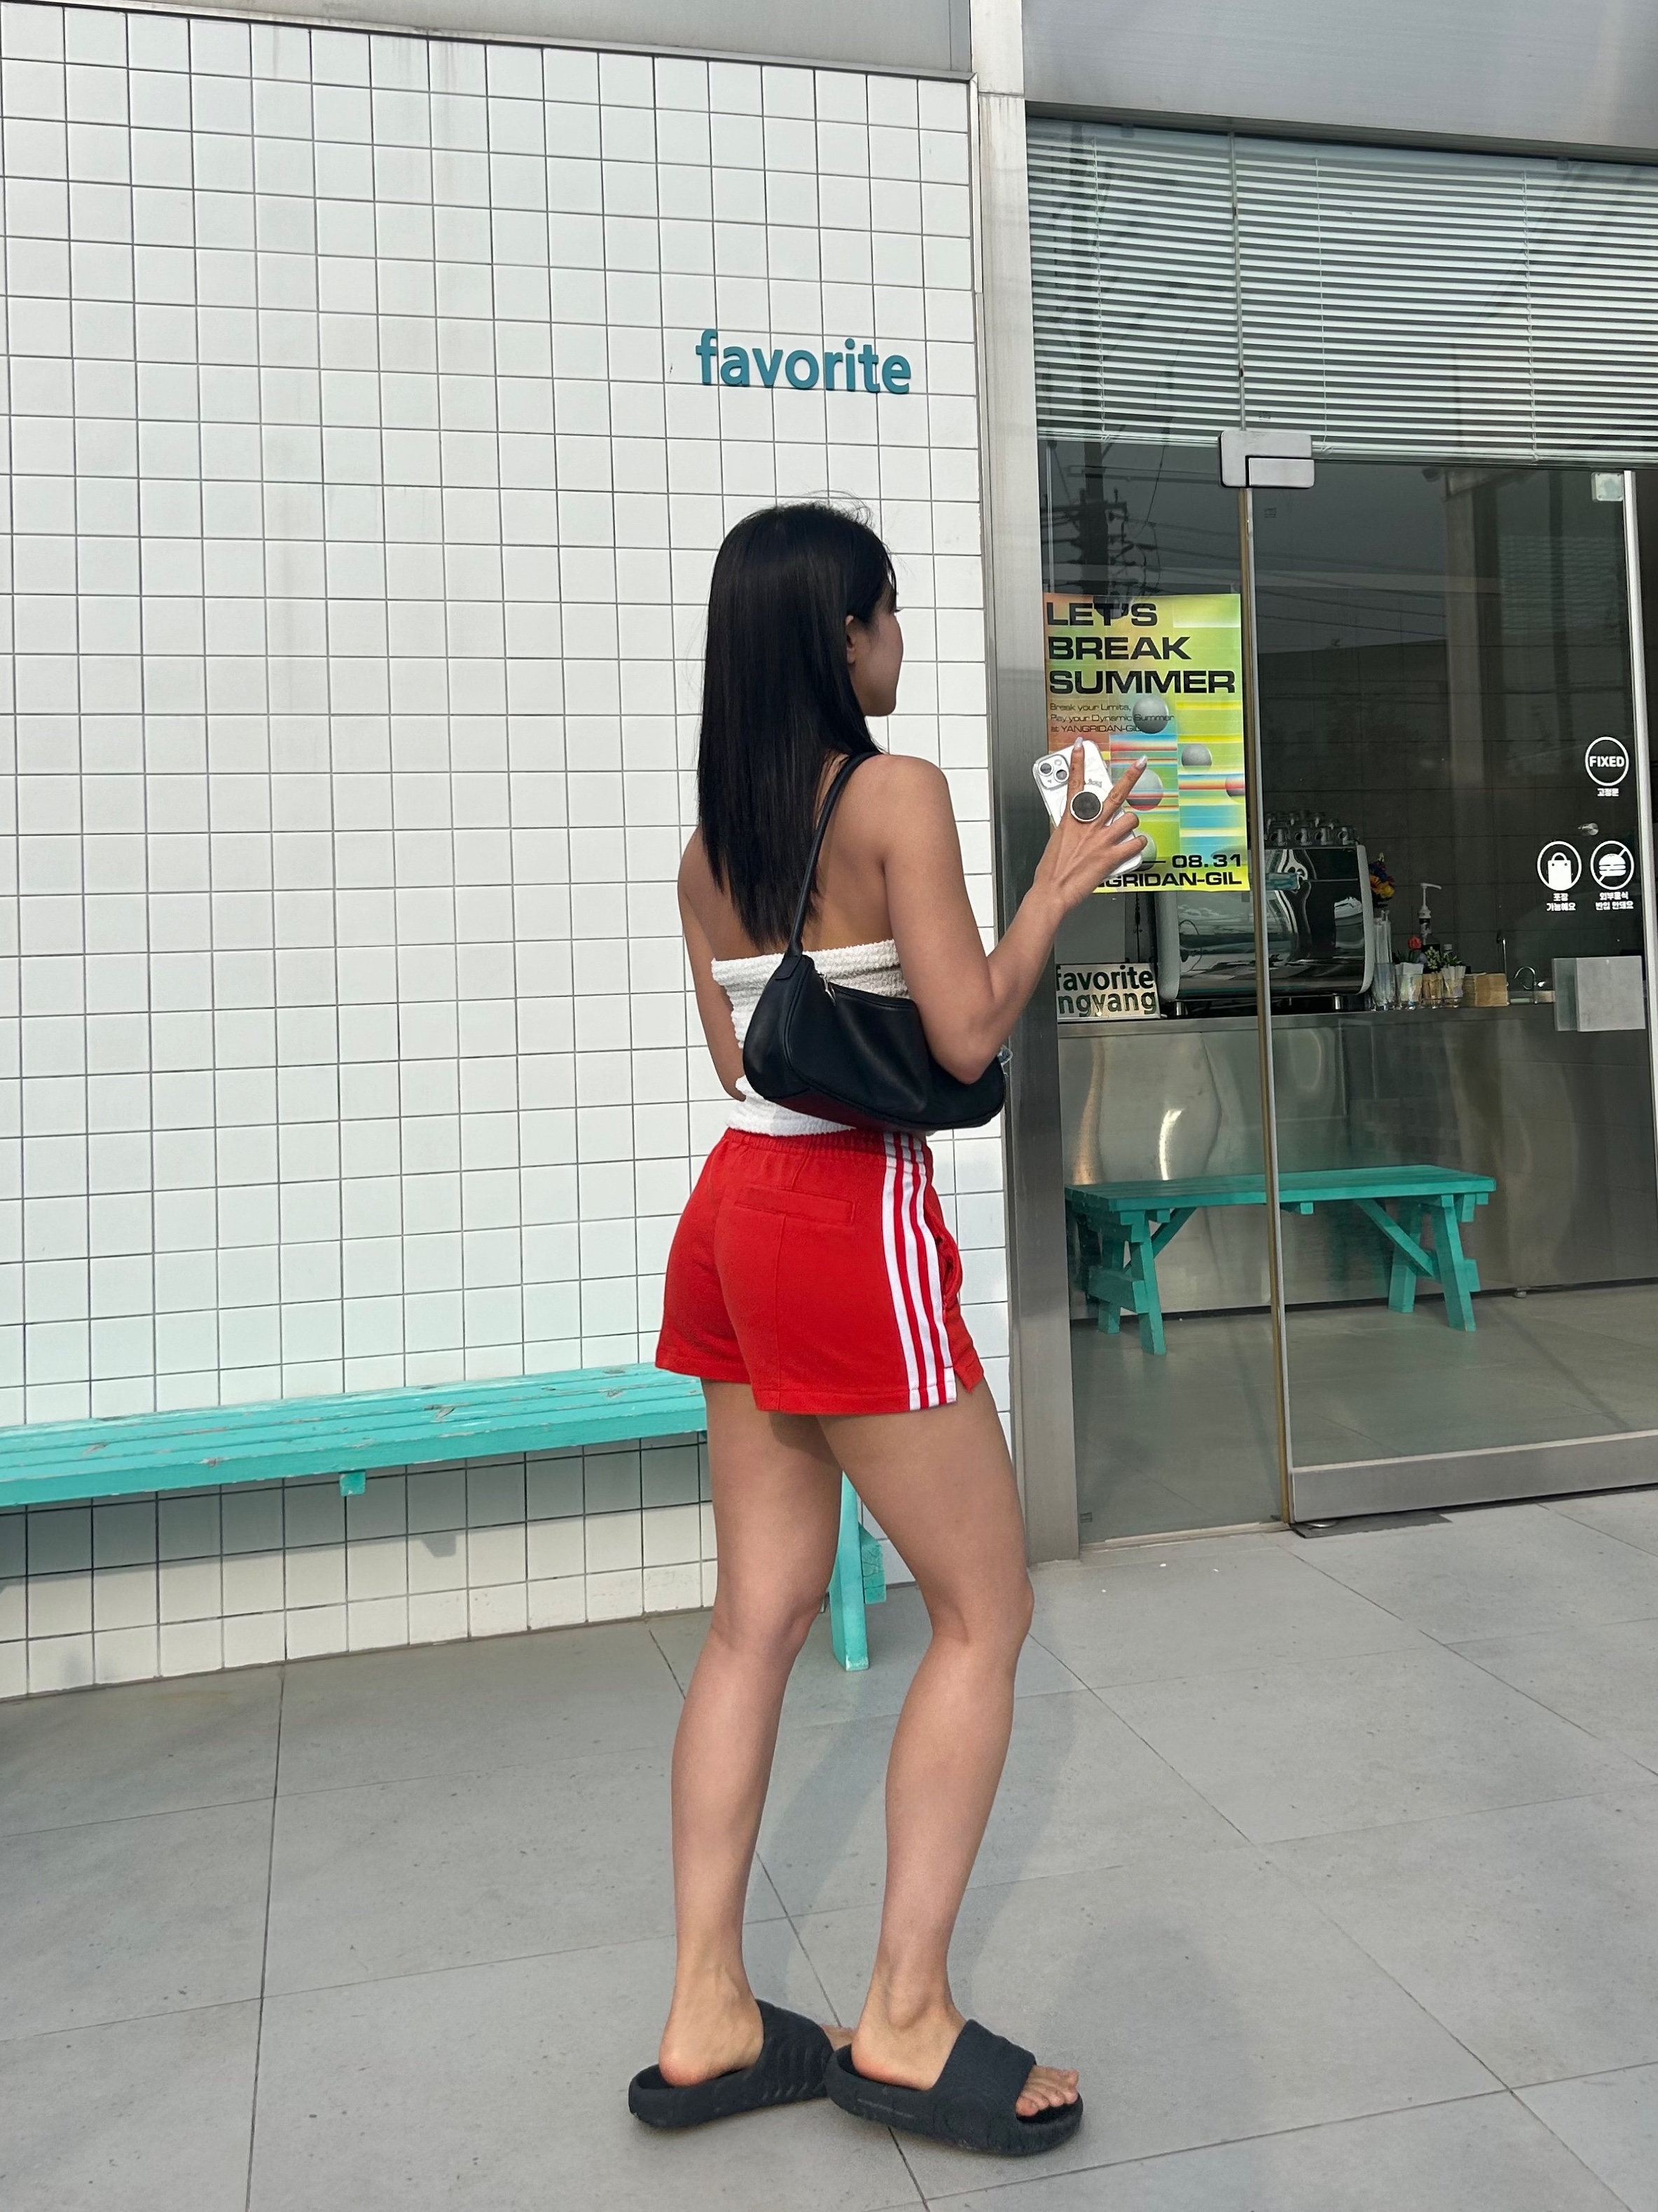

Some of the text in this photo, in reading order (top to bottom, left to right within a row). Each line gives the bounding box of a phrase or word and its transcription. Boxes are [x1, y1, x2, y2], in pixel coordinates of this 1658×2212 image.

[696, 329, 912, 394] favorite
[1046, 602, 1158, 626] LET'S
[1048, 636, 1192, 660] BREAK
[1049, 670, 1236, 694] SUMMER
[1050, 703, 1075, 711] Break
[1091, 714, 1133, 723] Dynamic
[1589, 755, 1625, 767] FIXED
[1597, 788, 1619, 797] 고정문
[1172, 853, 1241, 868] 08.31
[1098, 872, 1242, 888] GRIDAN-GIL
[1553, 893, 1568, 902] 포장
[1599, 891, 1629, 901] 외부음식
[1595, 901, 1610, 911] 반입
[1056, 964, 1154, 991] favorite
